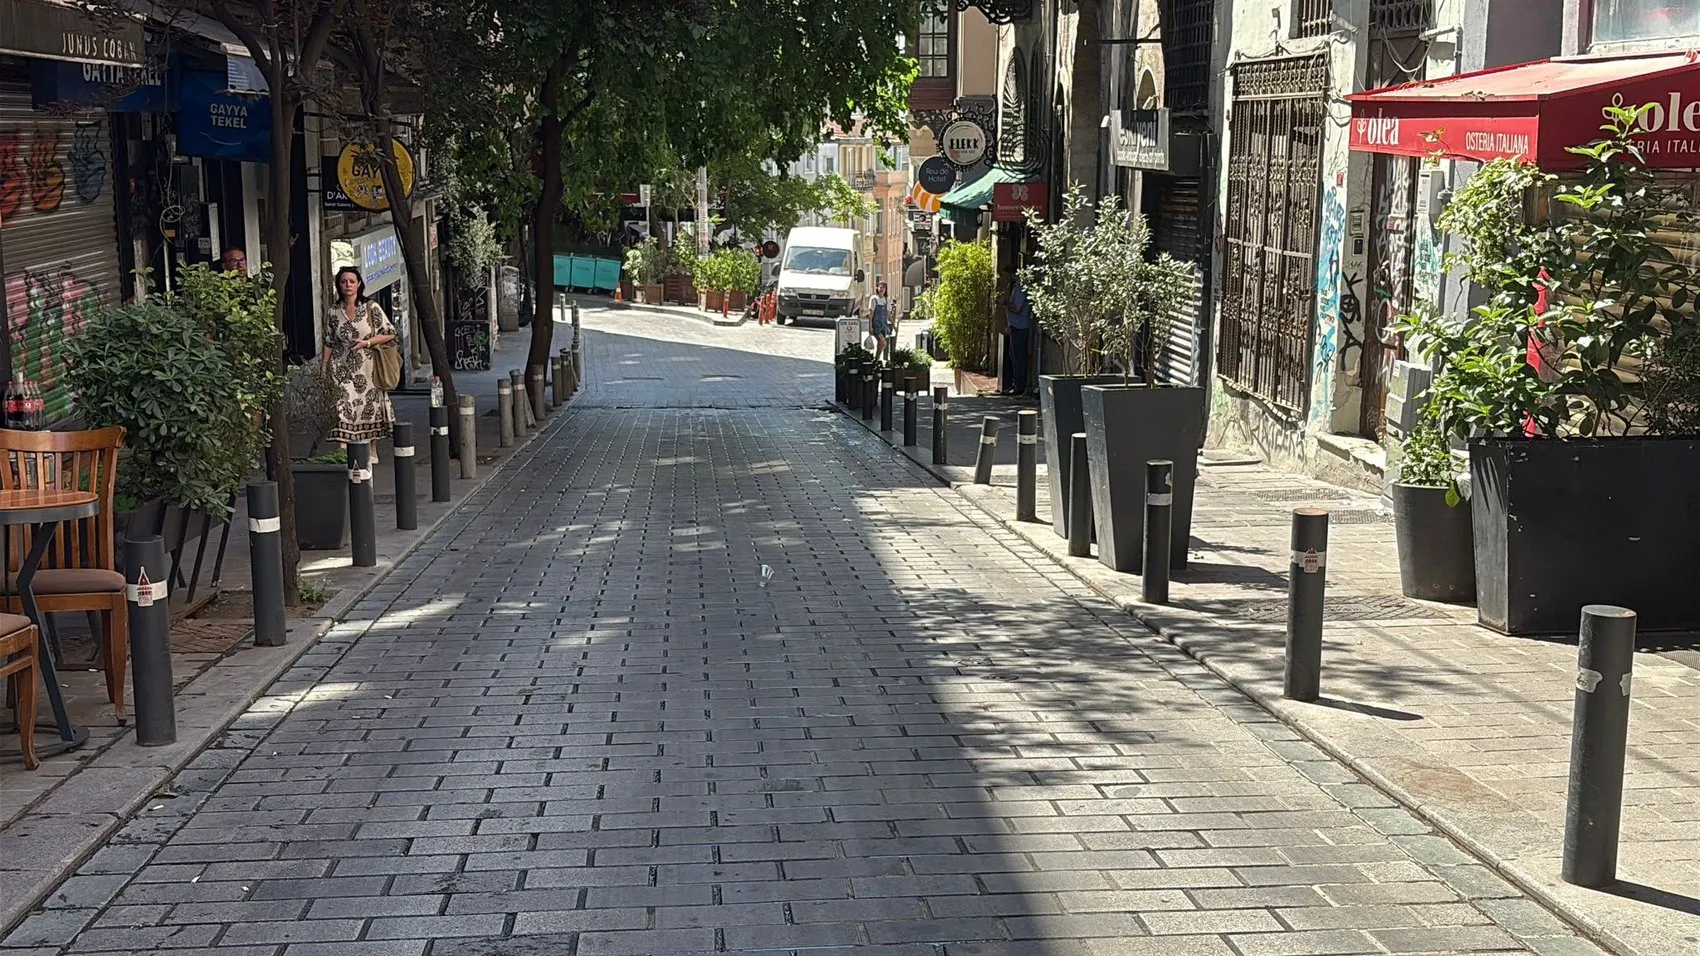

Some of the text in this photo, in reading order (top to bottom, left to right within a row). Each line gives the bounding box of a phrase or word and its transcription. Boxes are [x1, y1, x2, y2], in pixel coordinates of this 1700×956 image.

[62, 33, 98, 56] JUNUS
[210, 103, 248, 117] GAYYA
[210, 115, 247, 129] TEKEL
[1367, 107, 1400, 145] olea
[1465, 131, 1529, 154] OSTERIA ITALIANA
